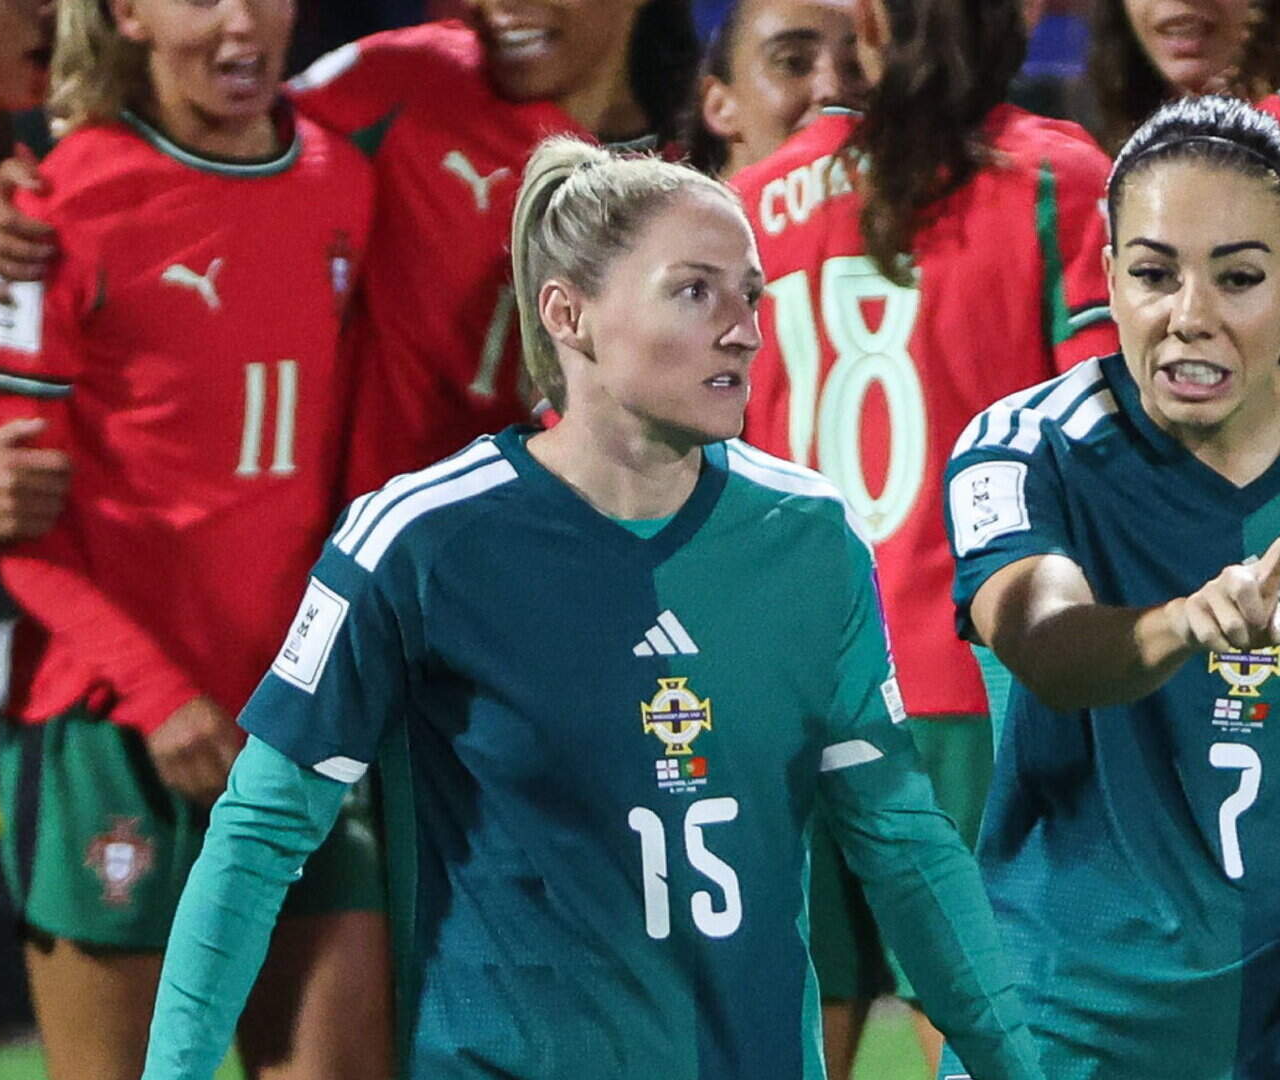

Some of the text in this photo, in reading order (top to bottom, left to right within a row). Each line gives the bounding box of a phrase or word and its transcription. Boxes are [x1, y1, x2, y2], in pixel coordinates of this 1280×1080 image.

[235, 359, 298, 474] 11
[764, 256, 927, 541] 18
[628, 797, 743, 939] 15
[1209, 742, 1262, 879] 7
